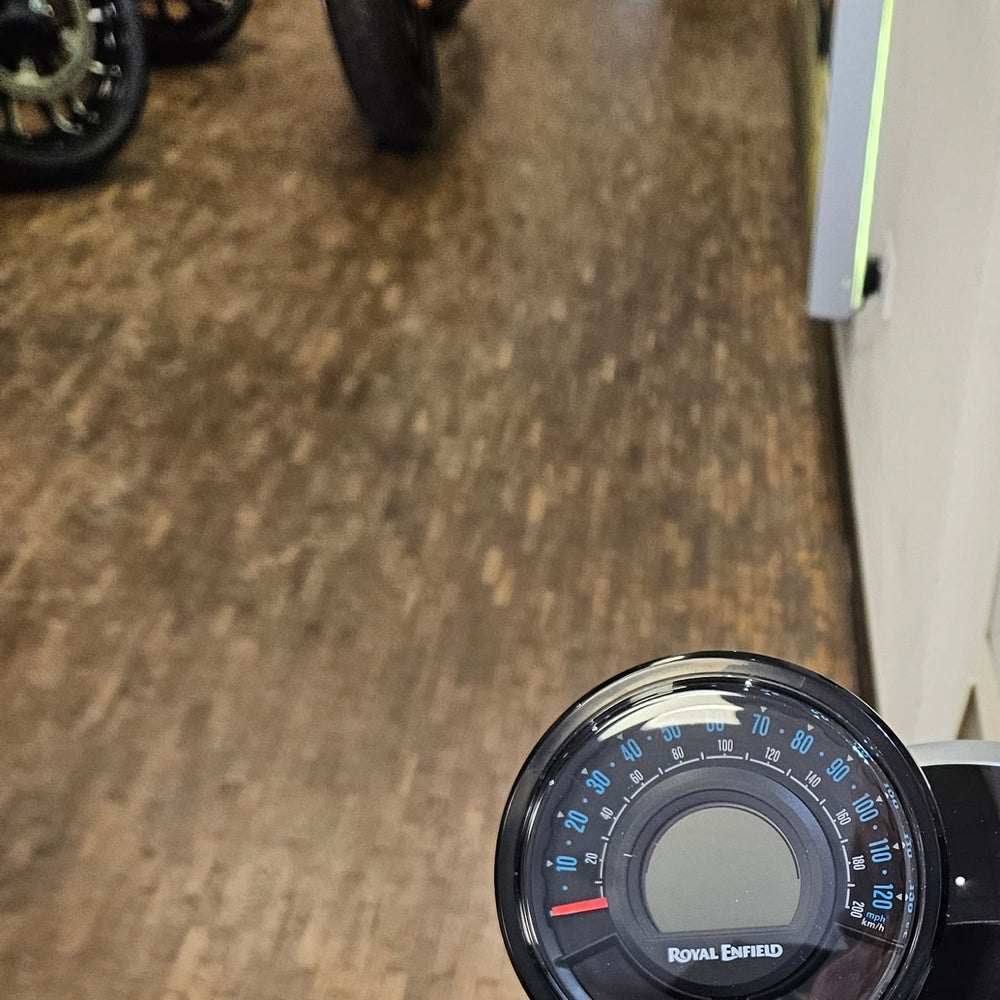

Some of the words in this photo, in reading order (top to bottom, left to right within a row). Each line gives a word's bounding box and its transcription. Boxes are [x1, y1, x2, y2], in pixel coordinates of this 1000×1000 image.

[752, 713, 770, 737] 70
[620, 738, 643, 762] 40
[717, 739, 734, 752] 100
[790, 729, 814, 754] 80
[671, 746, 684, 760] 80
[764, 746, 781, 763] 120
[629, 769, 644, 784] 60
[804, 770, 822, 788] 140
[826, 758, 850, 782] 90
[586, 769, 611, 795] 30
[600, 806, 614, 820] 40
[852, 793, 879, 822] 100
[564, 810, 588, 833] 20
[835, 808, 852, 826] 160
[585, 852, 599, 865] 20
[869, 838, 892, 863] 110
[556, 856, 578, 872] 10
[852, 855, 866, 871] 180
[872, 884, 894, 910] 120
[850, 900, 865, 919] 200
[866, 911, 886, 923] mph
[861, 917, 885, 932] km/h
